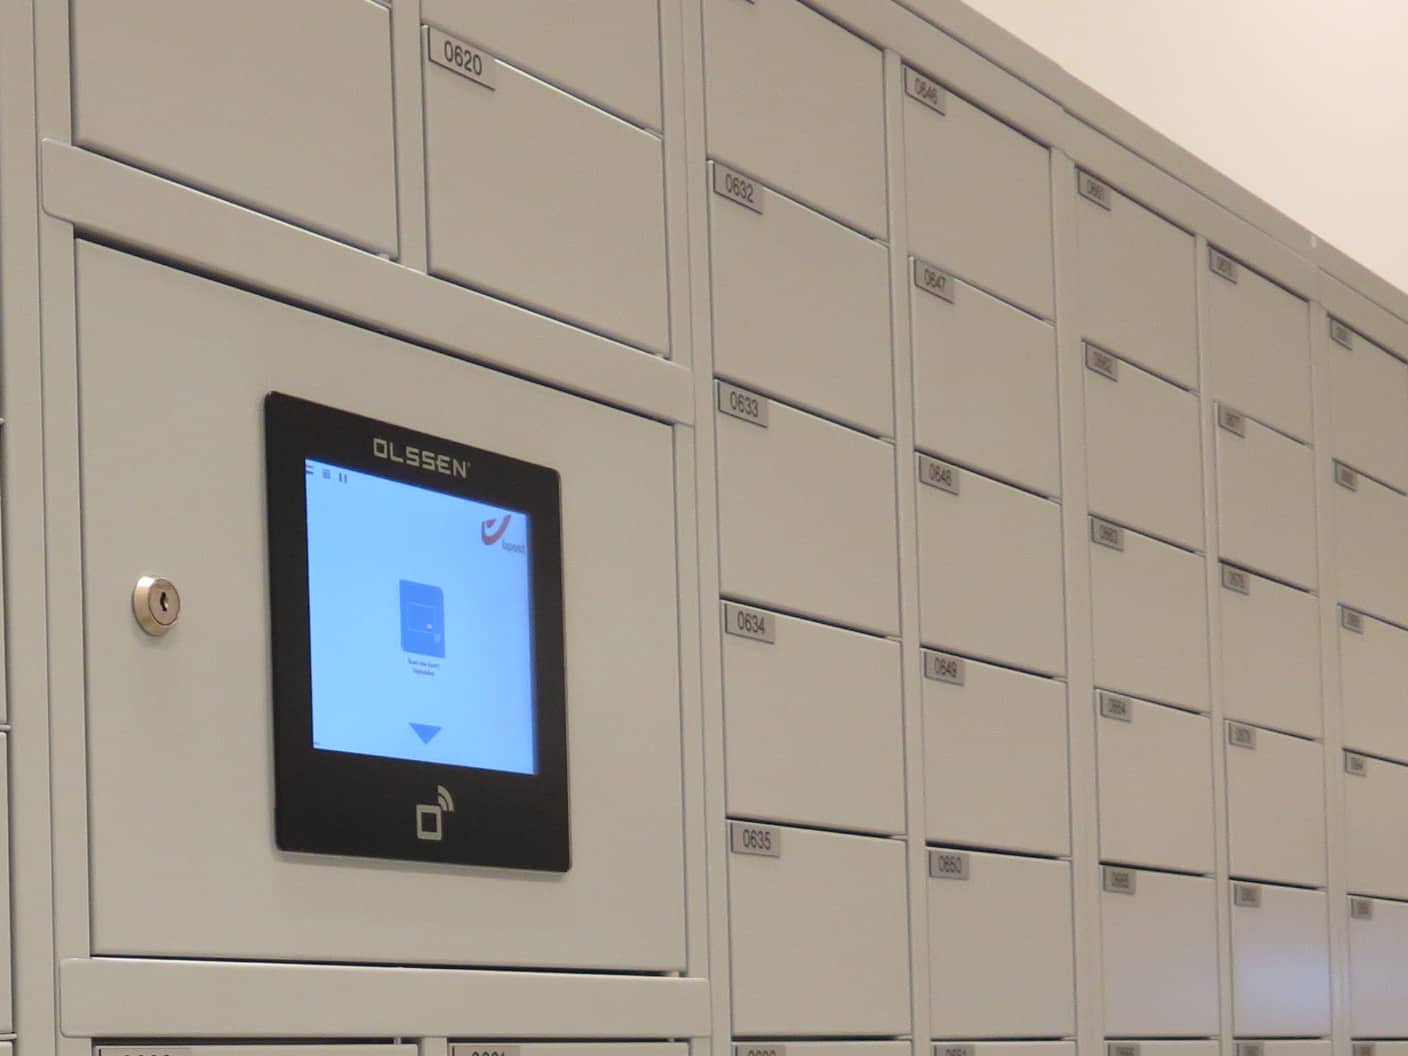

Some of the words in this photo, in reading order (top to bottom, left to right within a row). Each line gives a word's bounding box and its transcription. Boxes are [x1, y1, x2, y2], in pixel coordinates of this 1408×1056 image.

[444, 41, 483, 75] 0620
[725, 173, 754, 204] 0632
[731, 392, 758, 417] 0633
[373, 438, 467, 479] OLSSEN
[737, 610, 766, 634] 0634
[743, 829, 771, 850] 0635
